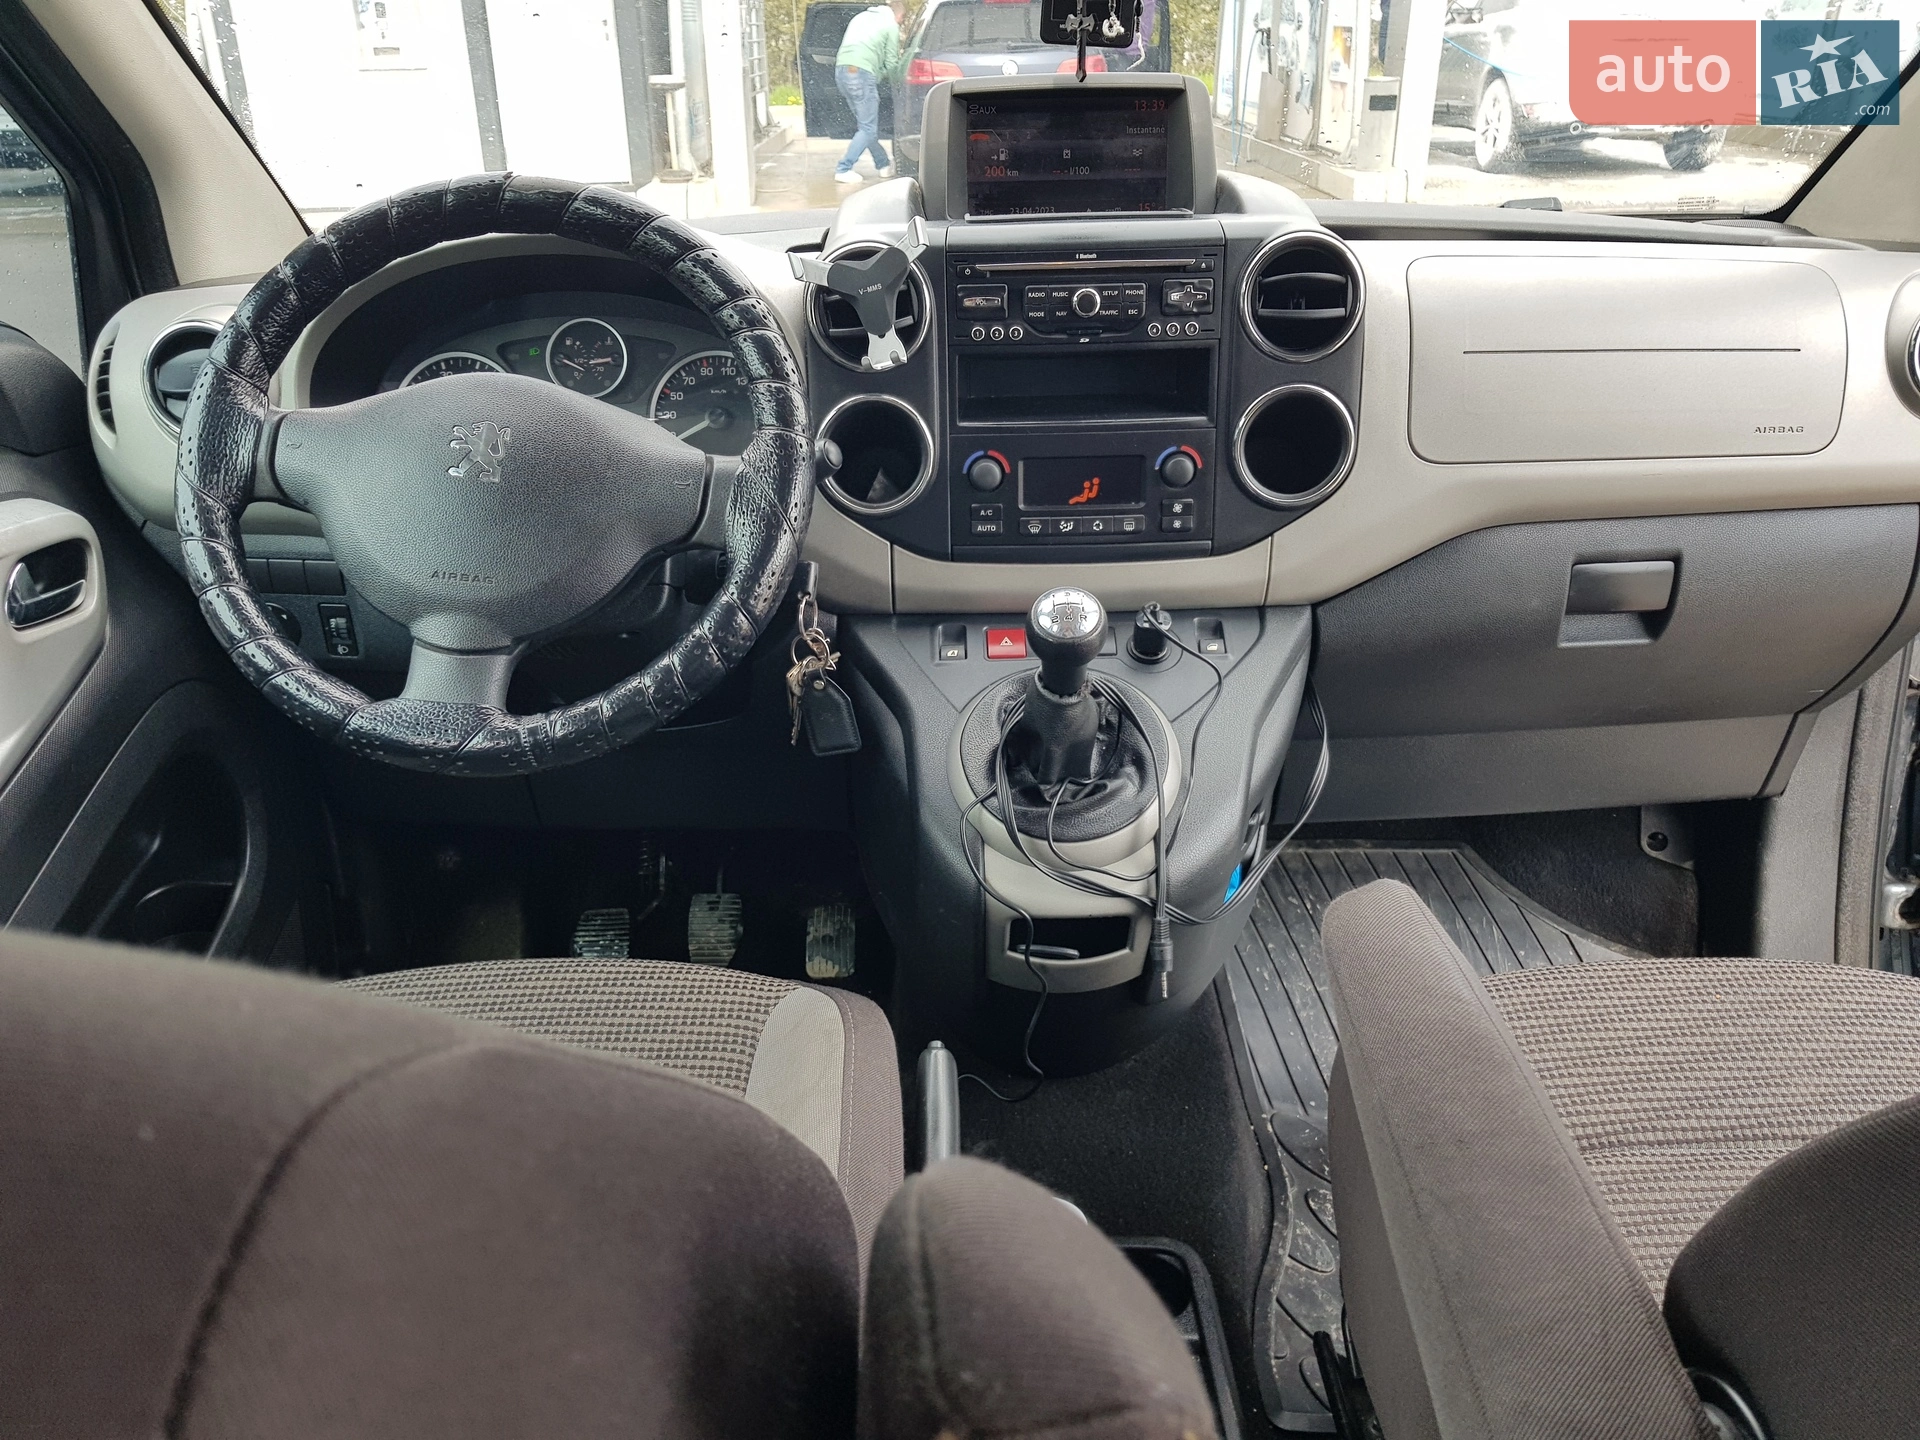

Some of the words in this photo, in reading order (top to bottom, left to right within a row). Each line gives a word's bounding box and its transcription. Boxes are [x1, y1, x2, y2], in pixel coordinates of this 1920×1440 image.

[979, 105, 997, 114] AUX
[1135, 99, 1165, 111] 13:39
[984, 165, 1006, 177] 200
[1007, 169, 1019, 177] km
[700, 368, 714, 376] 90
[720, 368, 736, 376] 110
[682, 377, 696, 386] 70
[670, 392, 684, 400] 50
[1753, 426, 1804, 434] AIRBAG
[431, 569, 495, 585] AIRBAG
